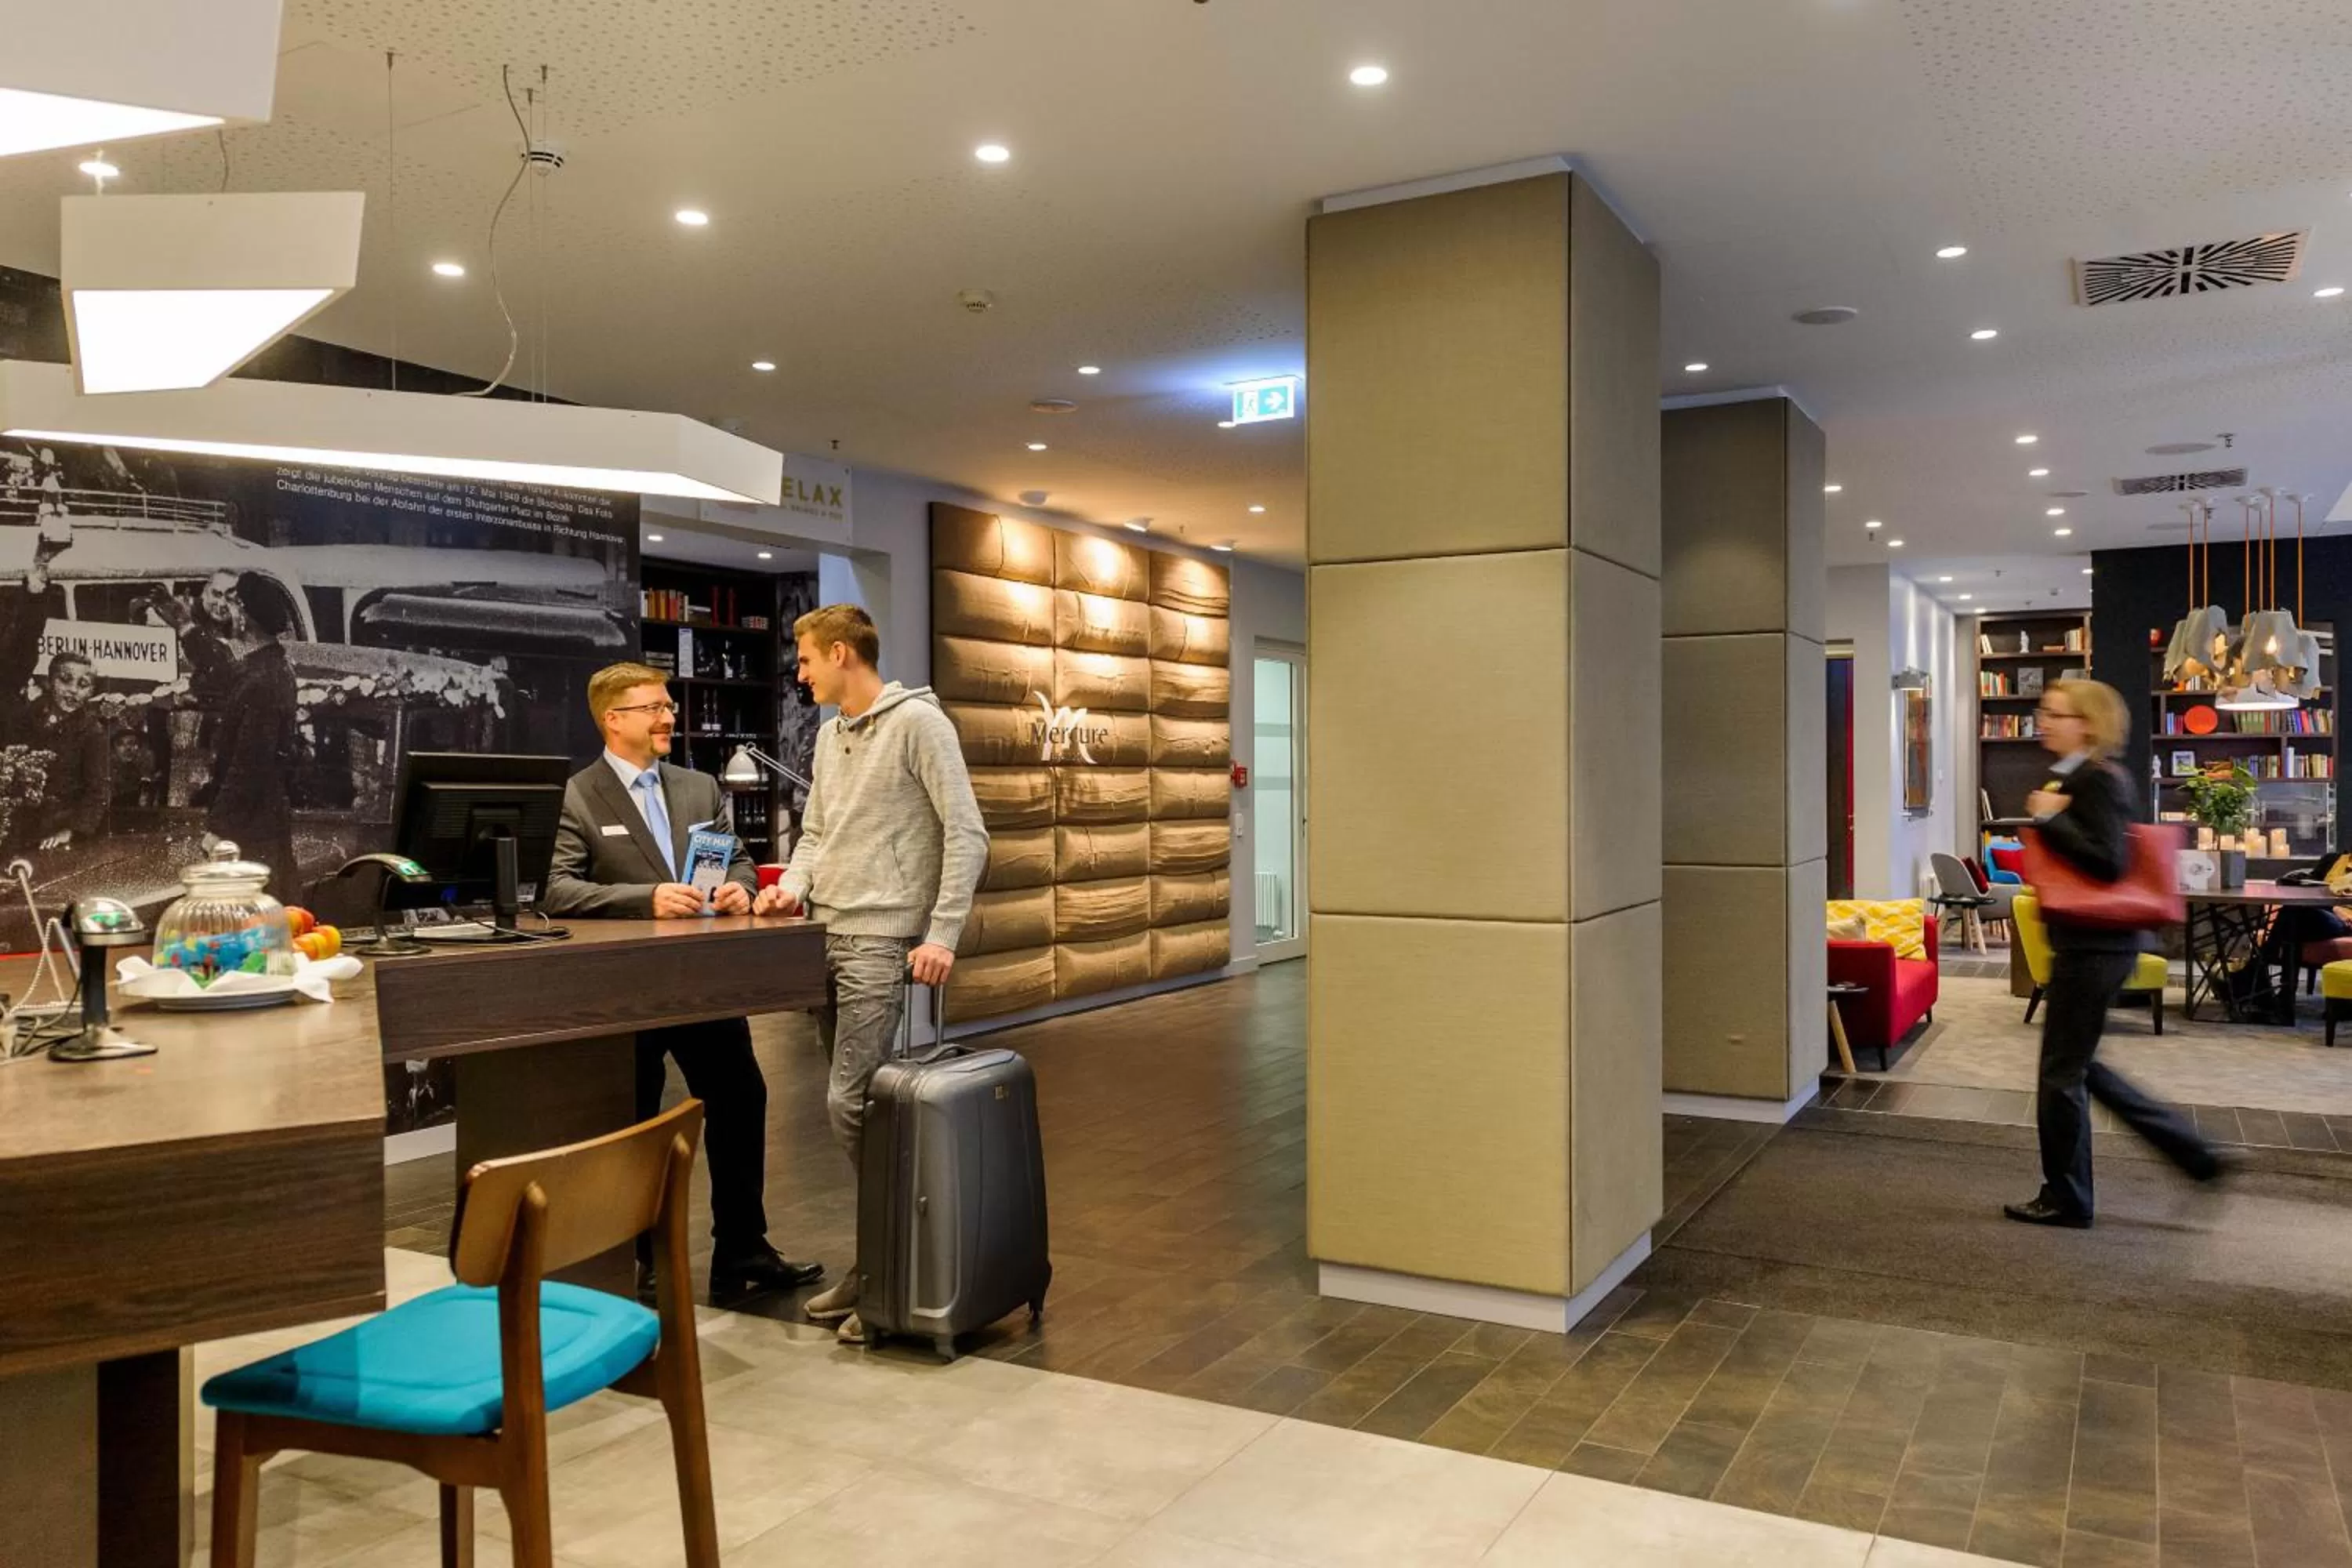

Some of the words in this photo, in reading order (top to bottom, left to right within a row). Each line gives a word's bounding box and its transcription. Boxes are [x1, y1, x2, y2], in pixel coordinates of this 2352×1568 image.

[277, 478, 352, 501] Charlottenburg
[372, 495, 388, 506] der
[391, 498, 425, 511] Abfahrt
[428, 504, 442, 514] der
[38, 635, 167, 662] BERLIN-HANNOVER
[1033, 721, 1109, 746] Mercure
[694, 834, 713, 844] CITY
[713, 837, 732, 847] MAP
